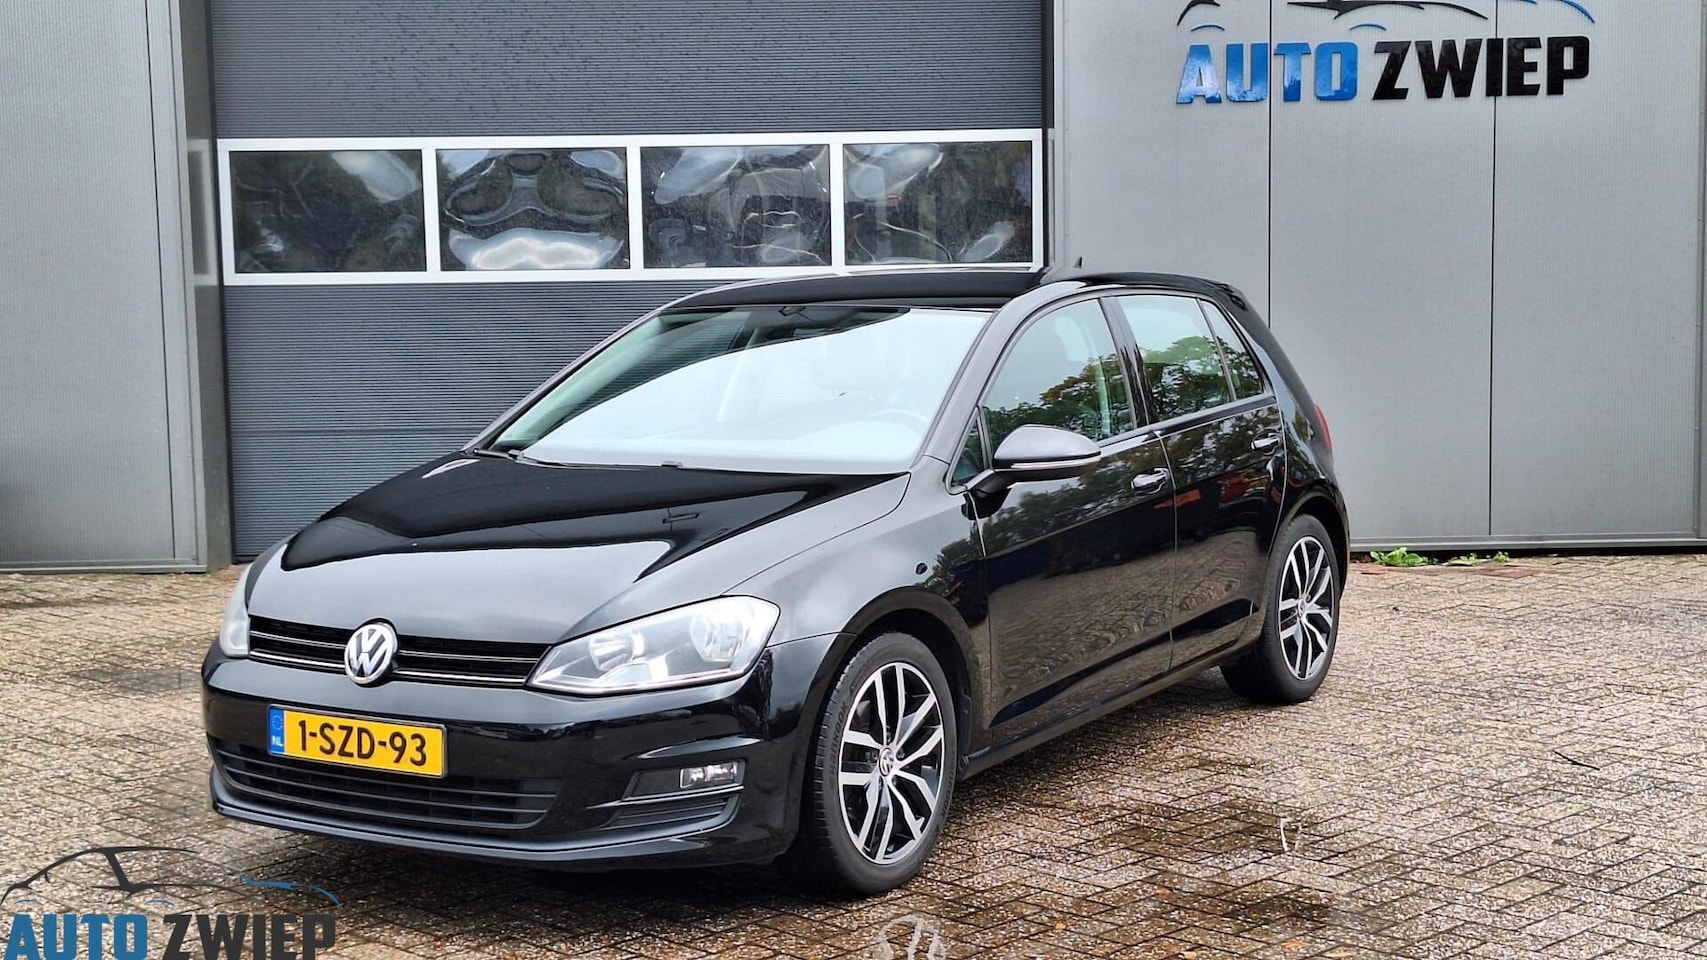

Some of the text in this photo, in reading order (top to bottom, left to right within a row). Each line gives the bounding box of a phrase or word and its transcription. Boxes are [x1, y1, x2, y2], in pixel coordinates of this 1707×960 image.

[1176, 36, 1590, 104] AUTO ZWIEP
[271, 735, 284, 747] NL
[297, 719, 427, 767] 1-SZD-93
